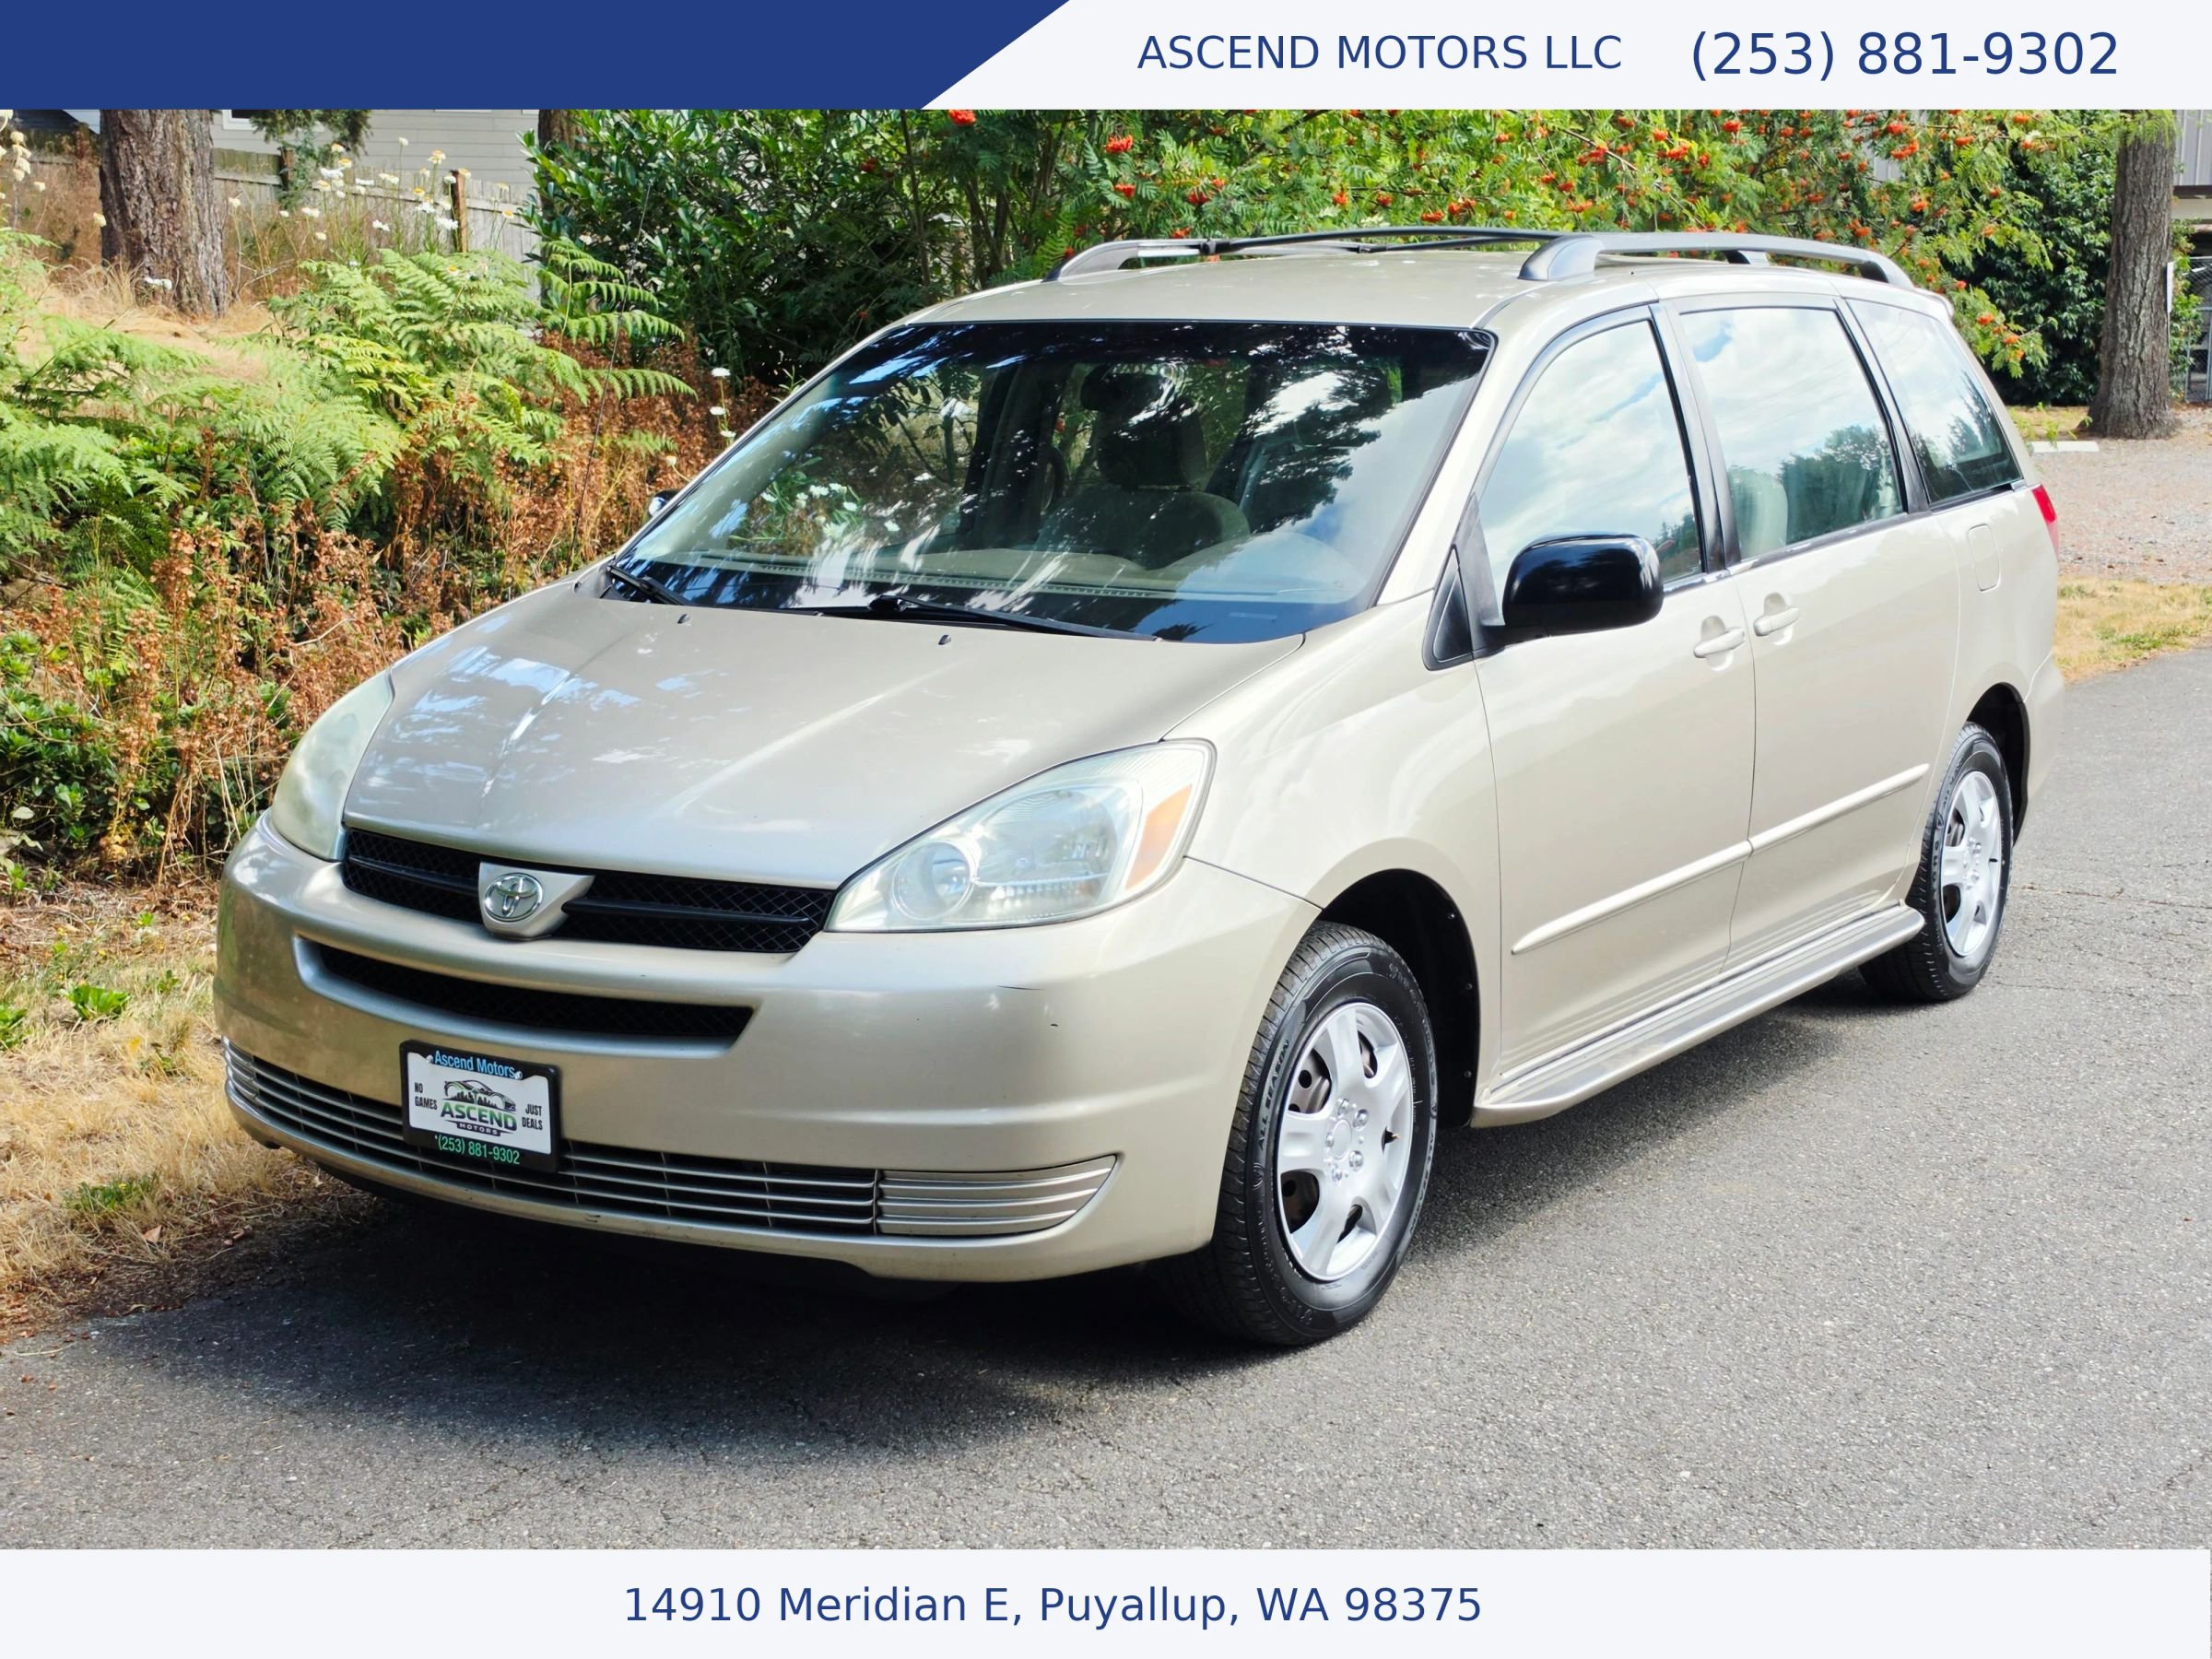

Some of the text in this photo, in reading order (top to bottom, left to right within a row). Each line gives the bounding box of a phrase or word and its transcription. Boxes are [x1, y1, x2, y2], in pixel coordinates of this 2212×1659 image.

[435, 1050, 516, 1079] Ascend Motors
[414, 1081, 423, 1094] NO
[415, 1096, 438, 1111] GAMES
[524, 1103, 542, 1116] JUST
[441, 1101, 518, 1132] ASCEND
[522, 1116, 543, 1131] DEALS
[459, 1123, 499, 1135] MOTORS
[438, 1135, 521, 1165] (253) 881-9302
